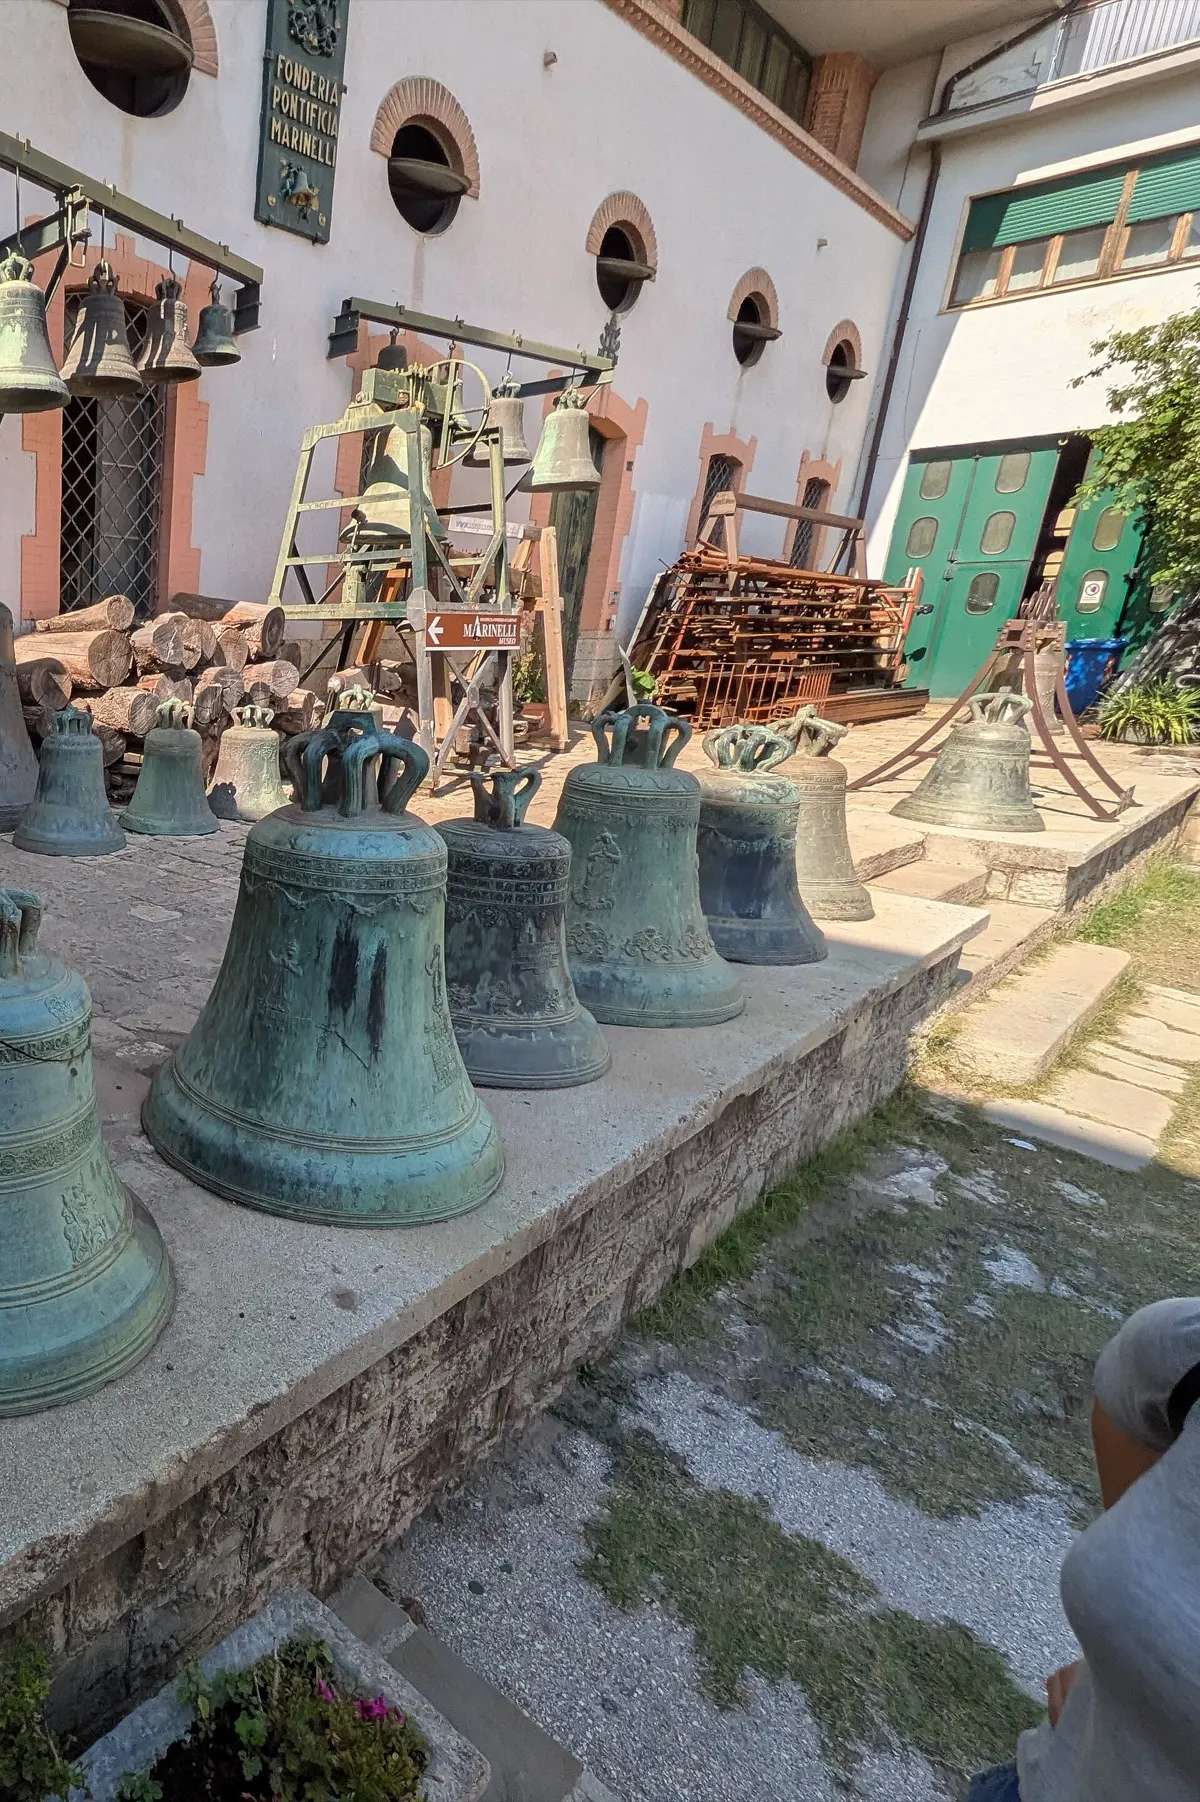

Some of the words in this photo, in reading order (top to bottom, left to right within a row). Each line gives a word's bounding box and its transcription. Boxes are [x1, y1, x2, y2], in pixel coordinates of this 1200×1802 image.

[276, 54, 339, 107] FONDERIA
[272, 85, 338, 139] PONTIFICIA
[270, 116, 337, 167] MARINELLI
[463, 615, 516, 638] MARINELLI
